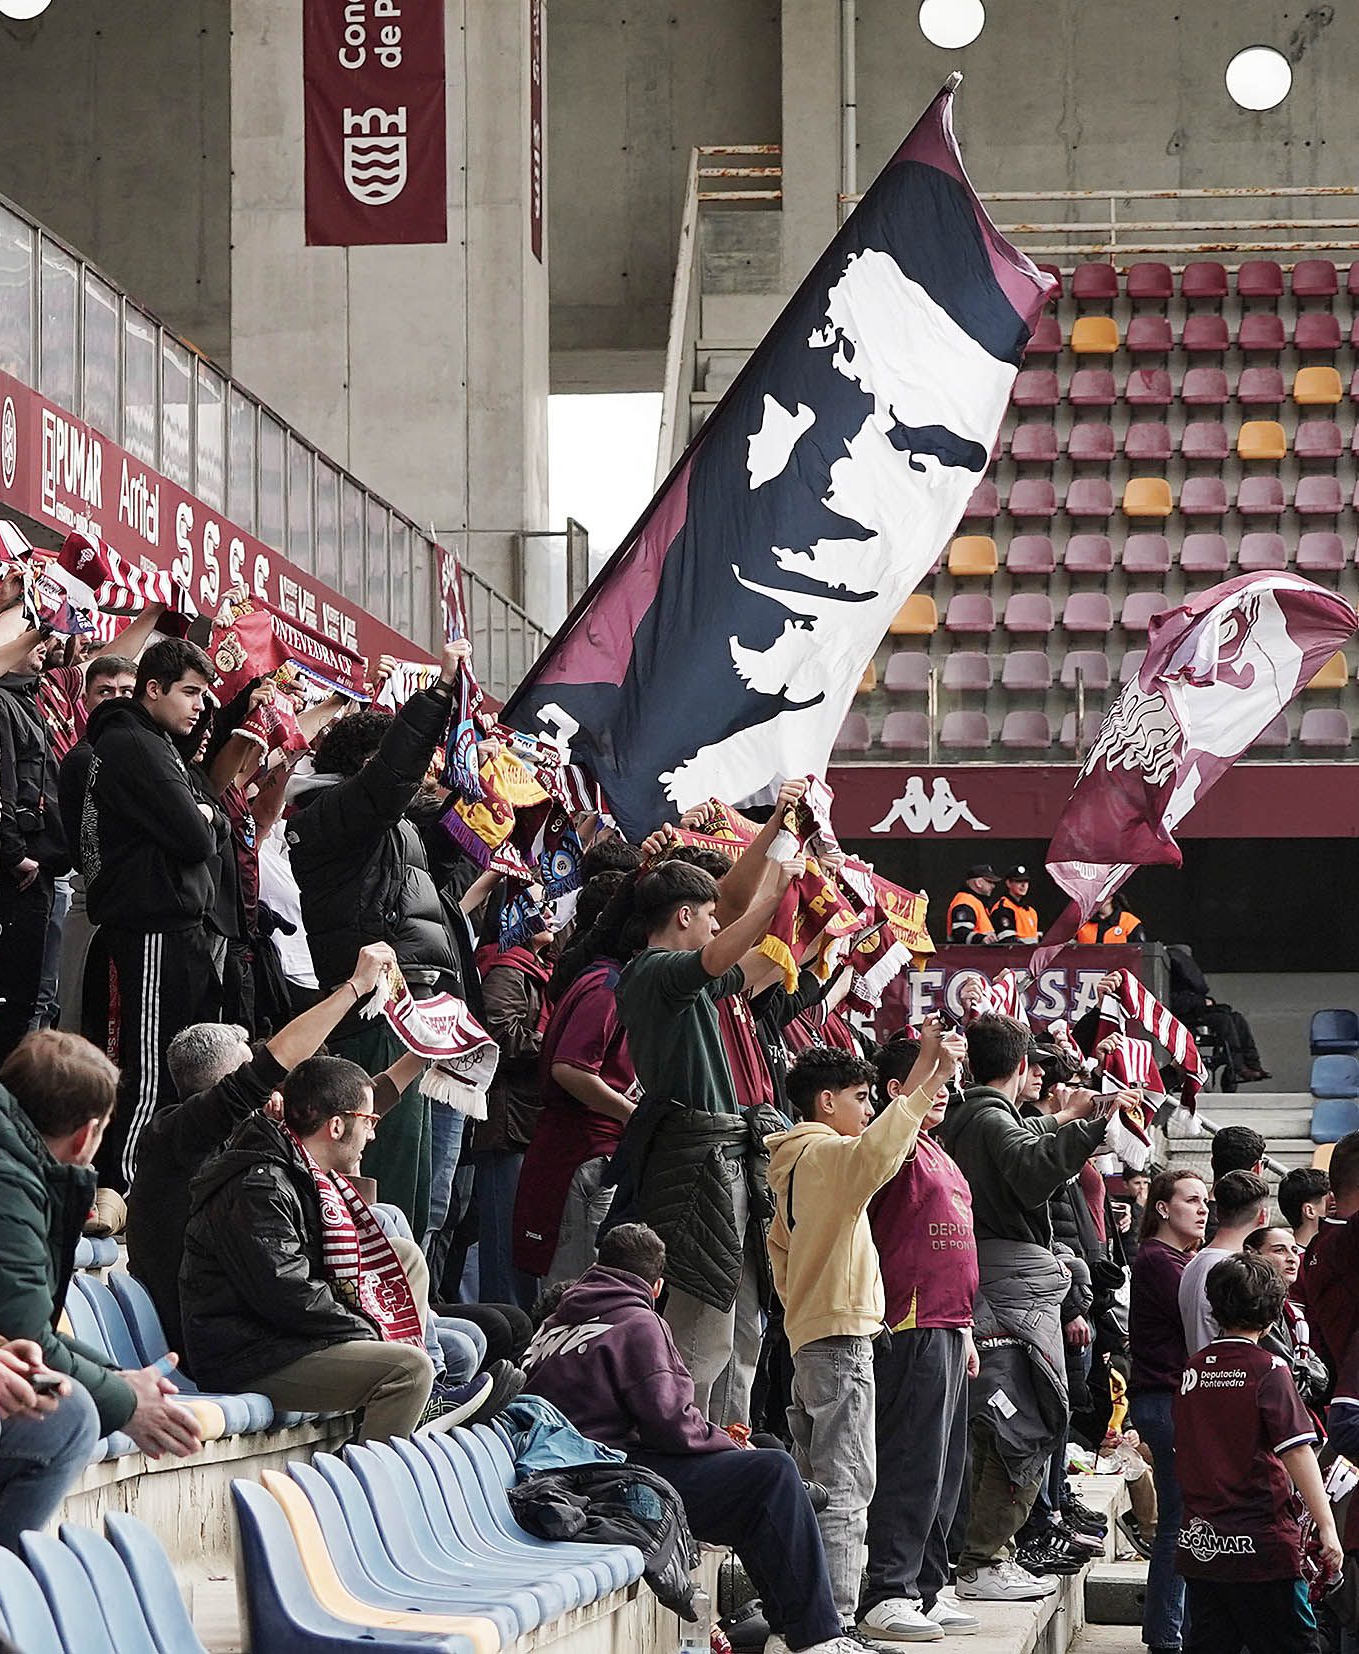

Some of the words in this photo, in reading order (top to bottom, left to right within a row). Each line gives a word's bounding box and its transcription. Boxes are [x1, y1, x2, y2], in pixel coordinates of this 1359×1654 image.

[338, 0, 366, 69] Con
[374, 25, 402, 68] de
[119, 458, 159, 546] Arrital
[265, 610, 340, 670] ONTEVEDRA
[338, 653, 353, 677] CF
[907, 968, 1109, 1027] FOSA
[932, 1240, 947, 1250] DE
[1200, 1369, 1247, 1380] Deputación
[1200, 1379, 1245, 1388] Pontevedra
